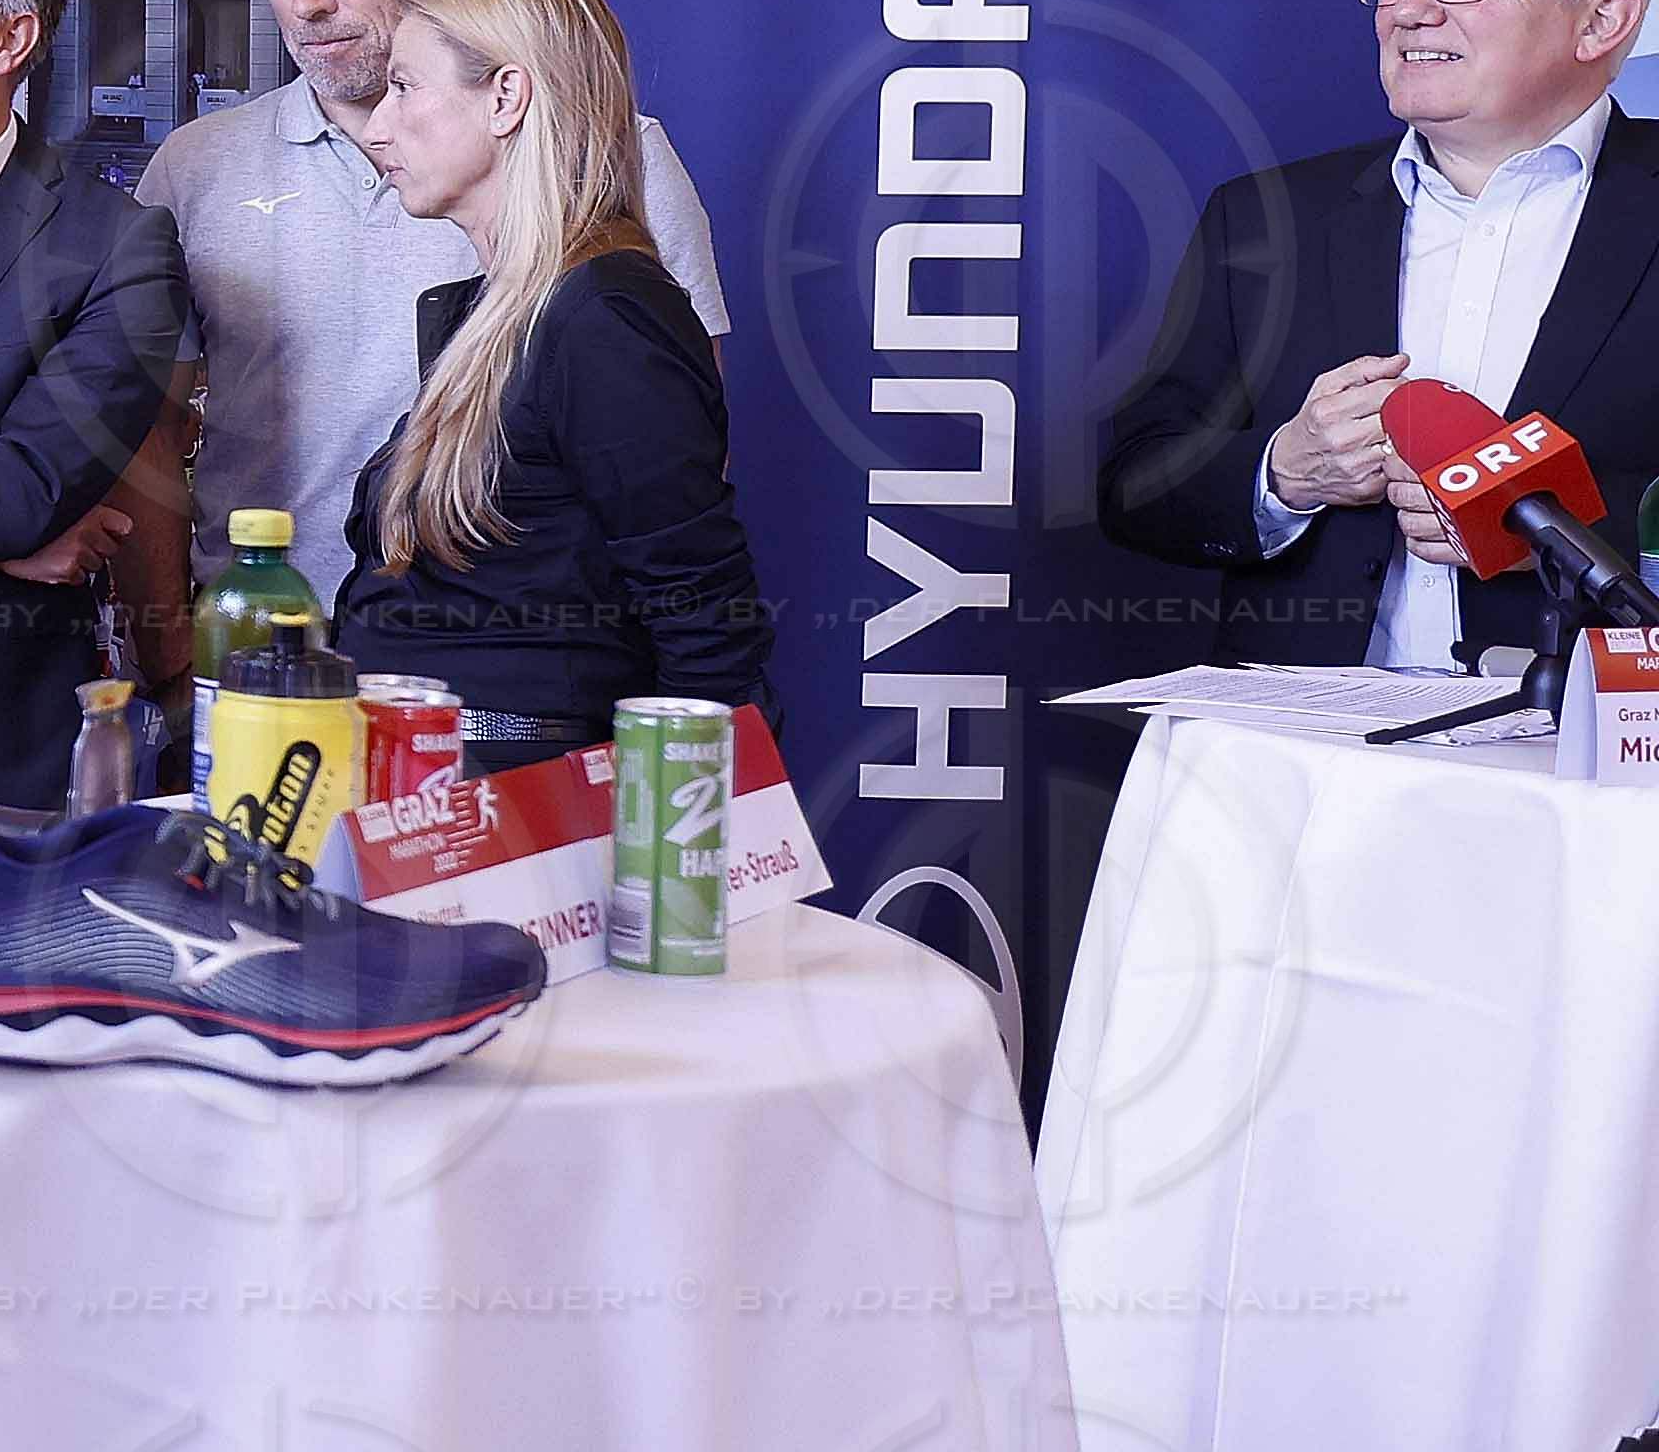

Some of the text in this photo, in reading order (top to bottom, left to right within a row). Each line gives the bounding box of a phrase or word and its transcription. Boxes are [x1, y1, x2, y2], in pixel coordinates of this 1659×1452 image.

[1438, 420, 1548, 492] ORF
[1607, 631, 1642, 640] KLEINE
[1618, 707, 1650, 722] Graz
[390, 785, 456, 835] GRAZ
[728, 838, 800, 892] er-Strauß
[522, 898, 603, 949] SINNER
